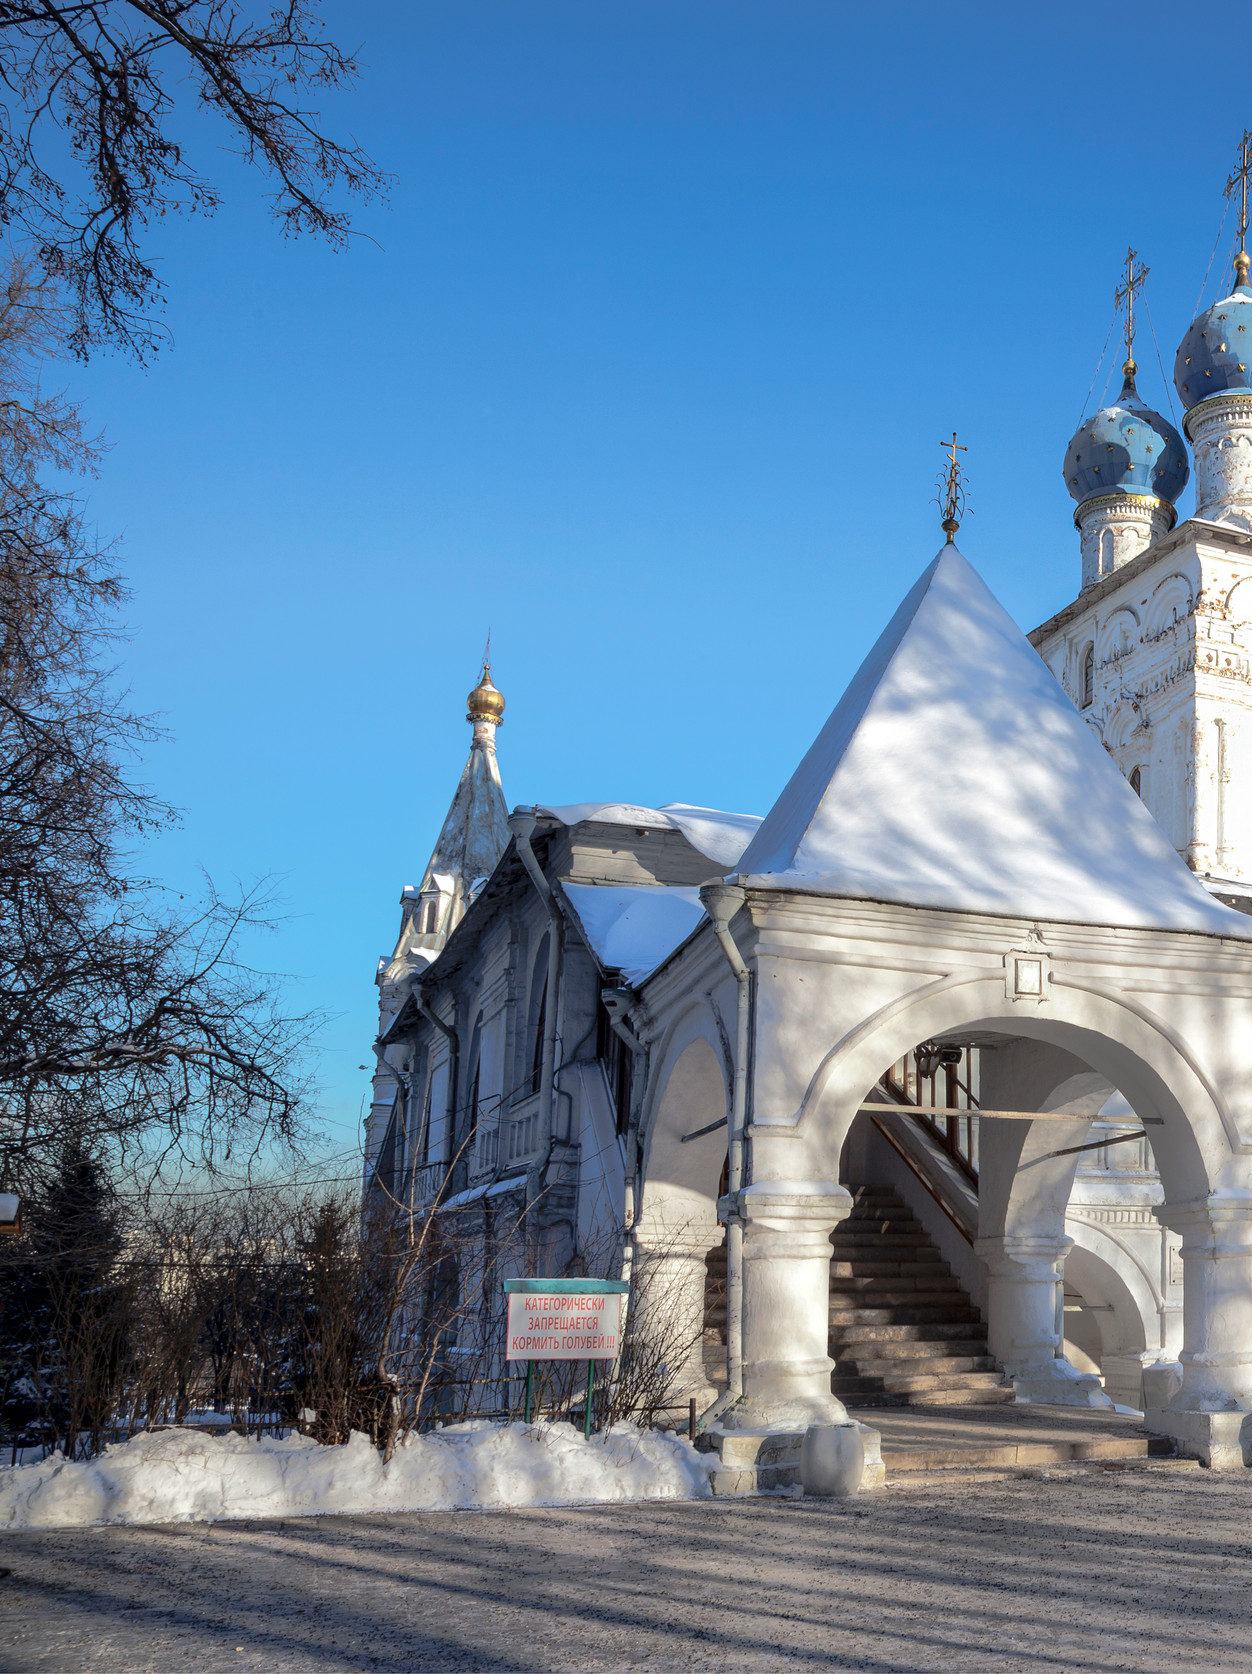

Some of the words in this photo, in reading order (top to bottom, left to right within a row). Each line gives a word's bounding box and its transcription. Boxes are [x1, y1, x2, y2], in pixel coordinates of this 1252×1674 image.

[524, 1297, 605, 1311] КАТЕГОРИЧЕСКИ
[528, 1317, 599, 1333] ЗАПРЕЩАЕТСЯ
[512, 1336, 560, 1350] КОРМИТЬ
[561, 1333, 605, 1350] ГОЛУБЕЙ
